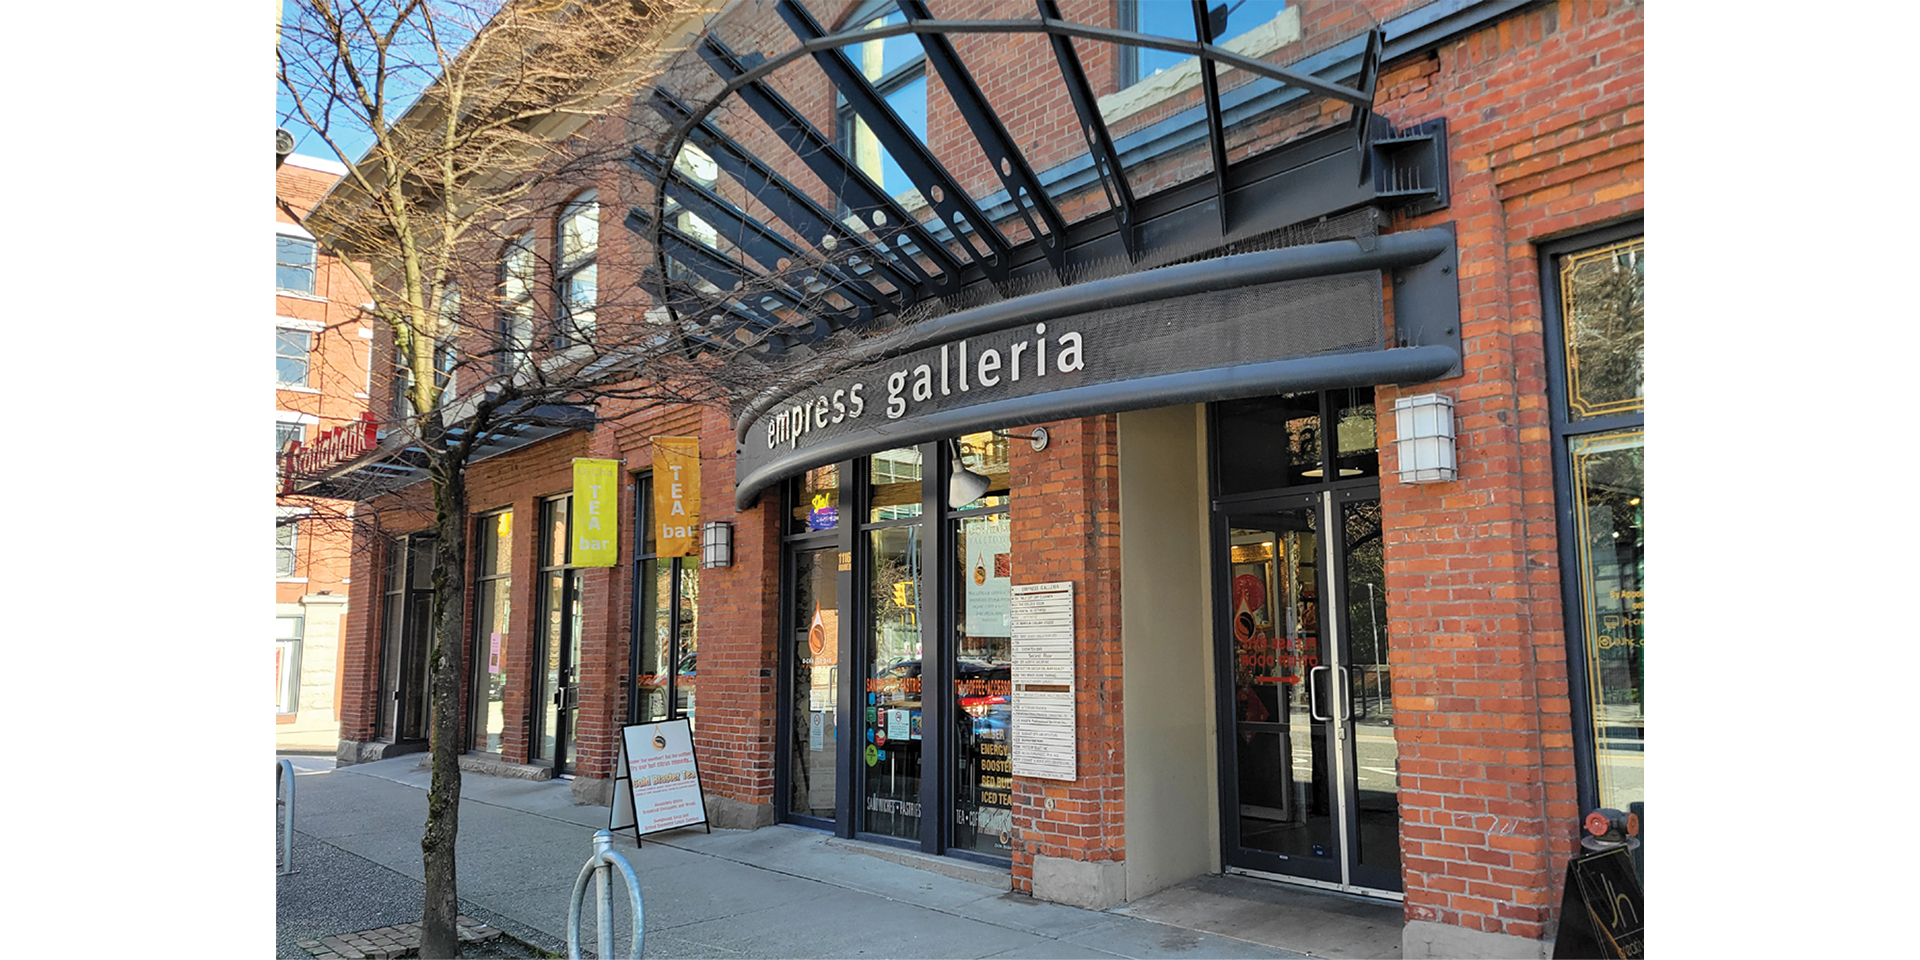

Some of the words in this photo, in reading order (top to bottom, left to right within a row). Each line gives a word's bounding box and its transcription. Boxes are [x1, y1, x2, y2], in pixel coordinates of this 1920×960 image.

[767, 383, 865, 450] empress
[886, 323, 1086, 419] galleria
[577, 466, 613, 477] O-Cha
[579, 536, 610, 550] bar
[980, 743, 1008, 756] ENERGY
[682, 769, 696, 780] Tea
[981, 791, 998, 803] ICED
